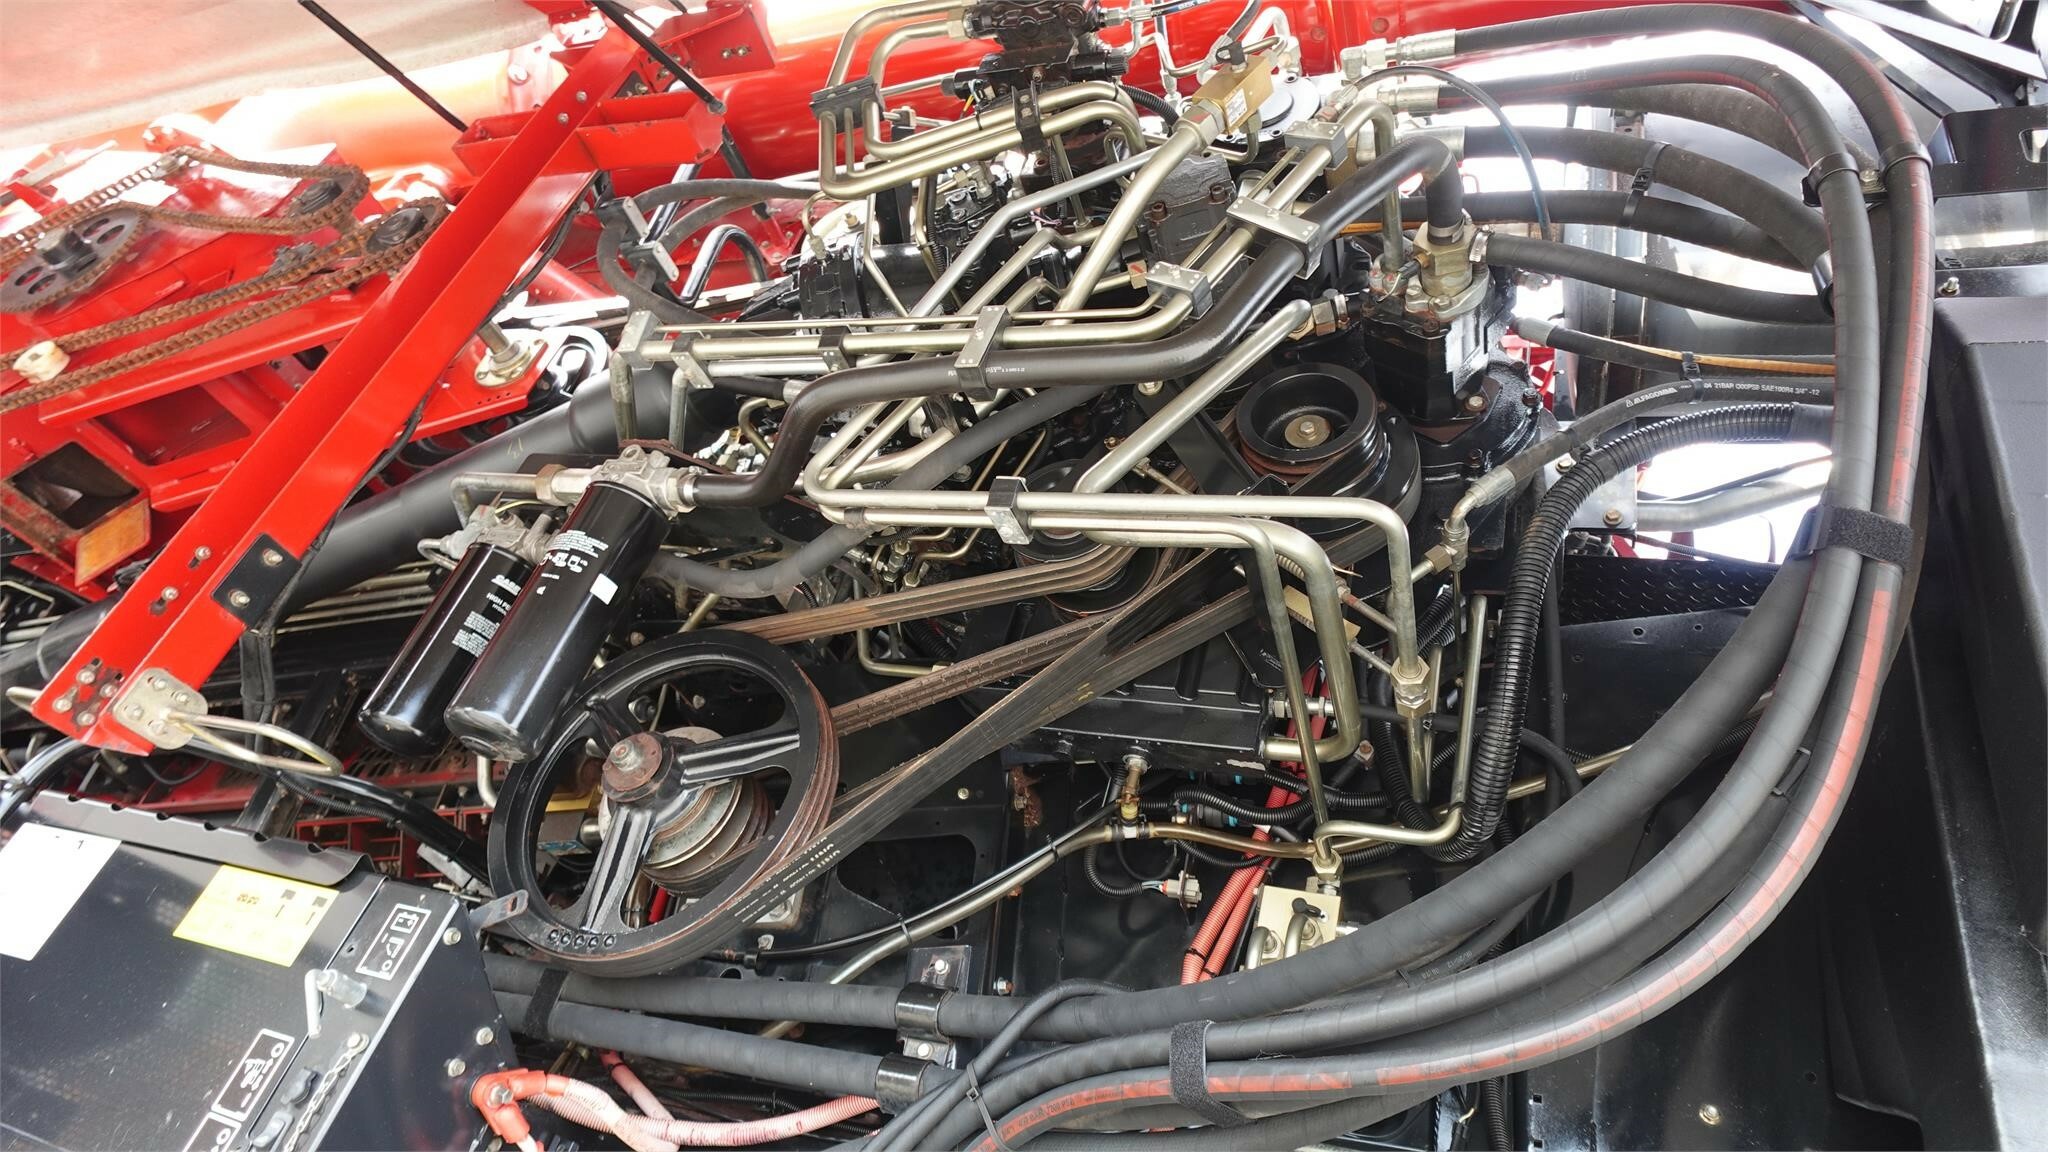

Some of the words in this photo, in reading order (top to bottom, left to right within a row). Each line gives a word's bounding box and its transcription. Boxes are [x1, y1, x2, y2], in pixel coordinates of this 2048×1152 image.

[1633, 387, 1678, 404] ALFAGOMMA
[1761, 384, 1794, 394] SAE100R4
[491, 574, 521, 596] CASE
[486, 592, 504, 606] HIGH
